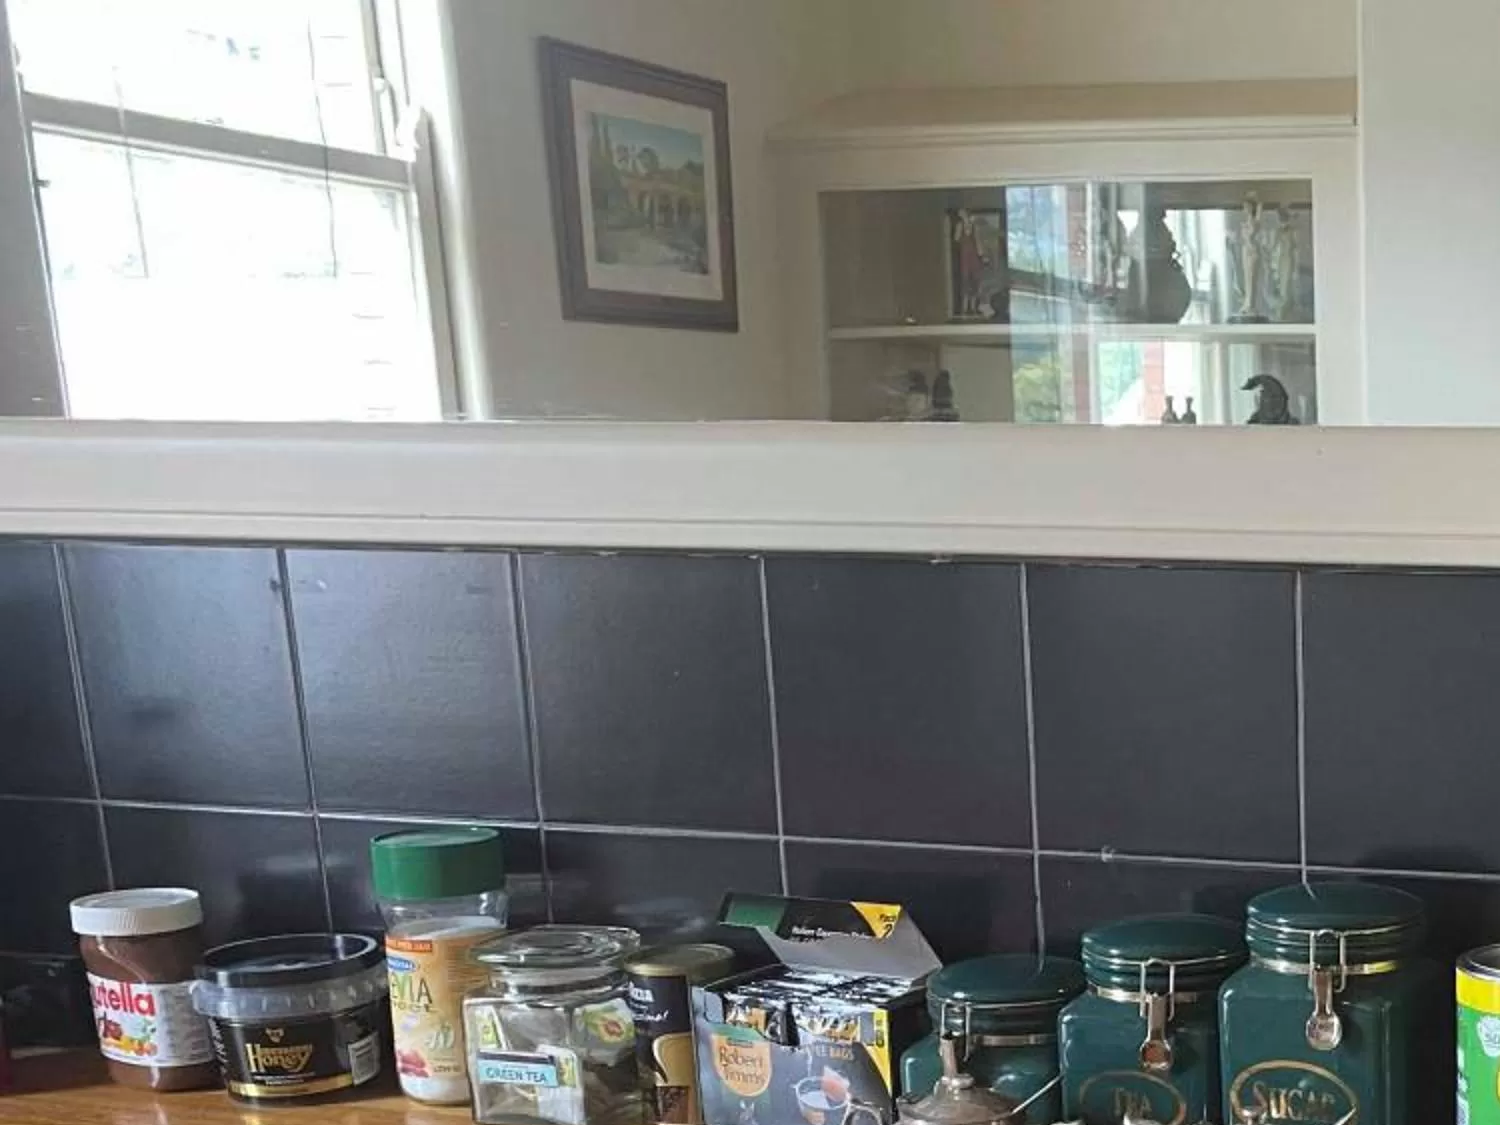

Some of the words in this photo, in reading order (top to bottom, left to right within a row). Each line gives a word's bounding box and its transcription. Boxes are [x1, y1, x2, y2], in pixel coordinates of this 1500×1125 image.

[95, 981, 156, 1017] utella
[485, 1066, 523, 1081] GREEN
[525, 1070, 549, 1083] TEA
